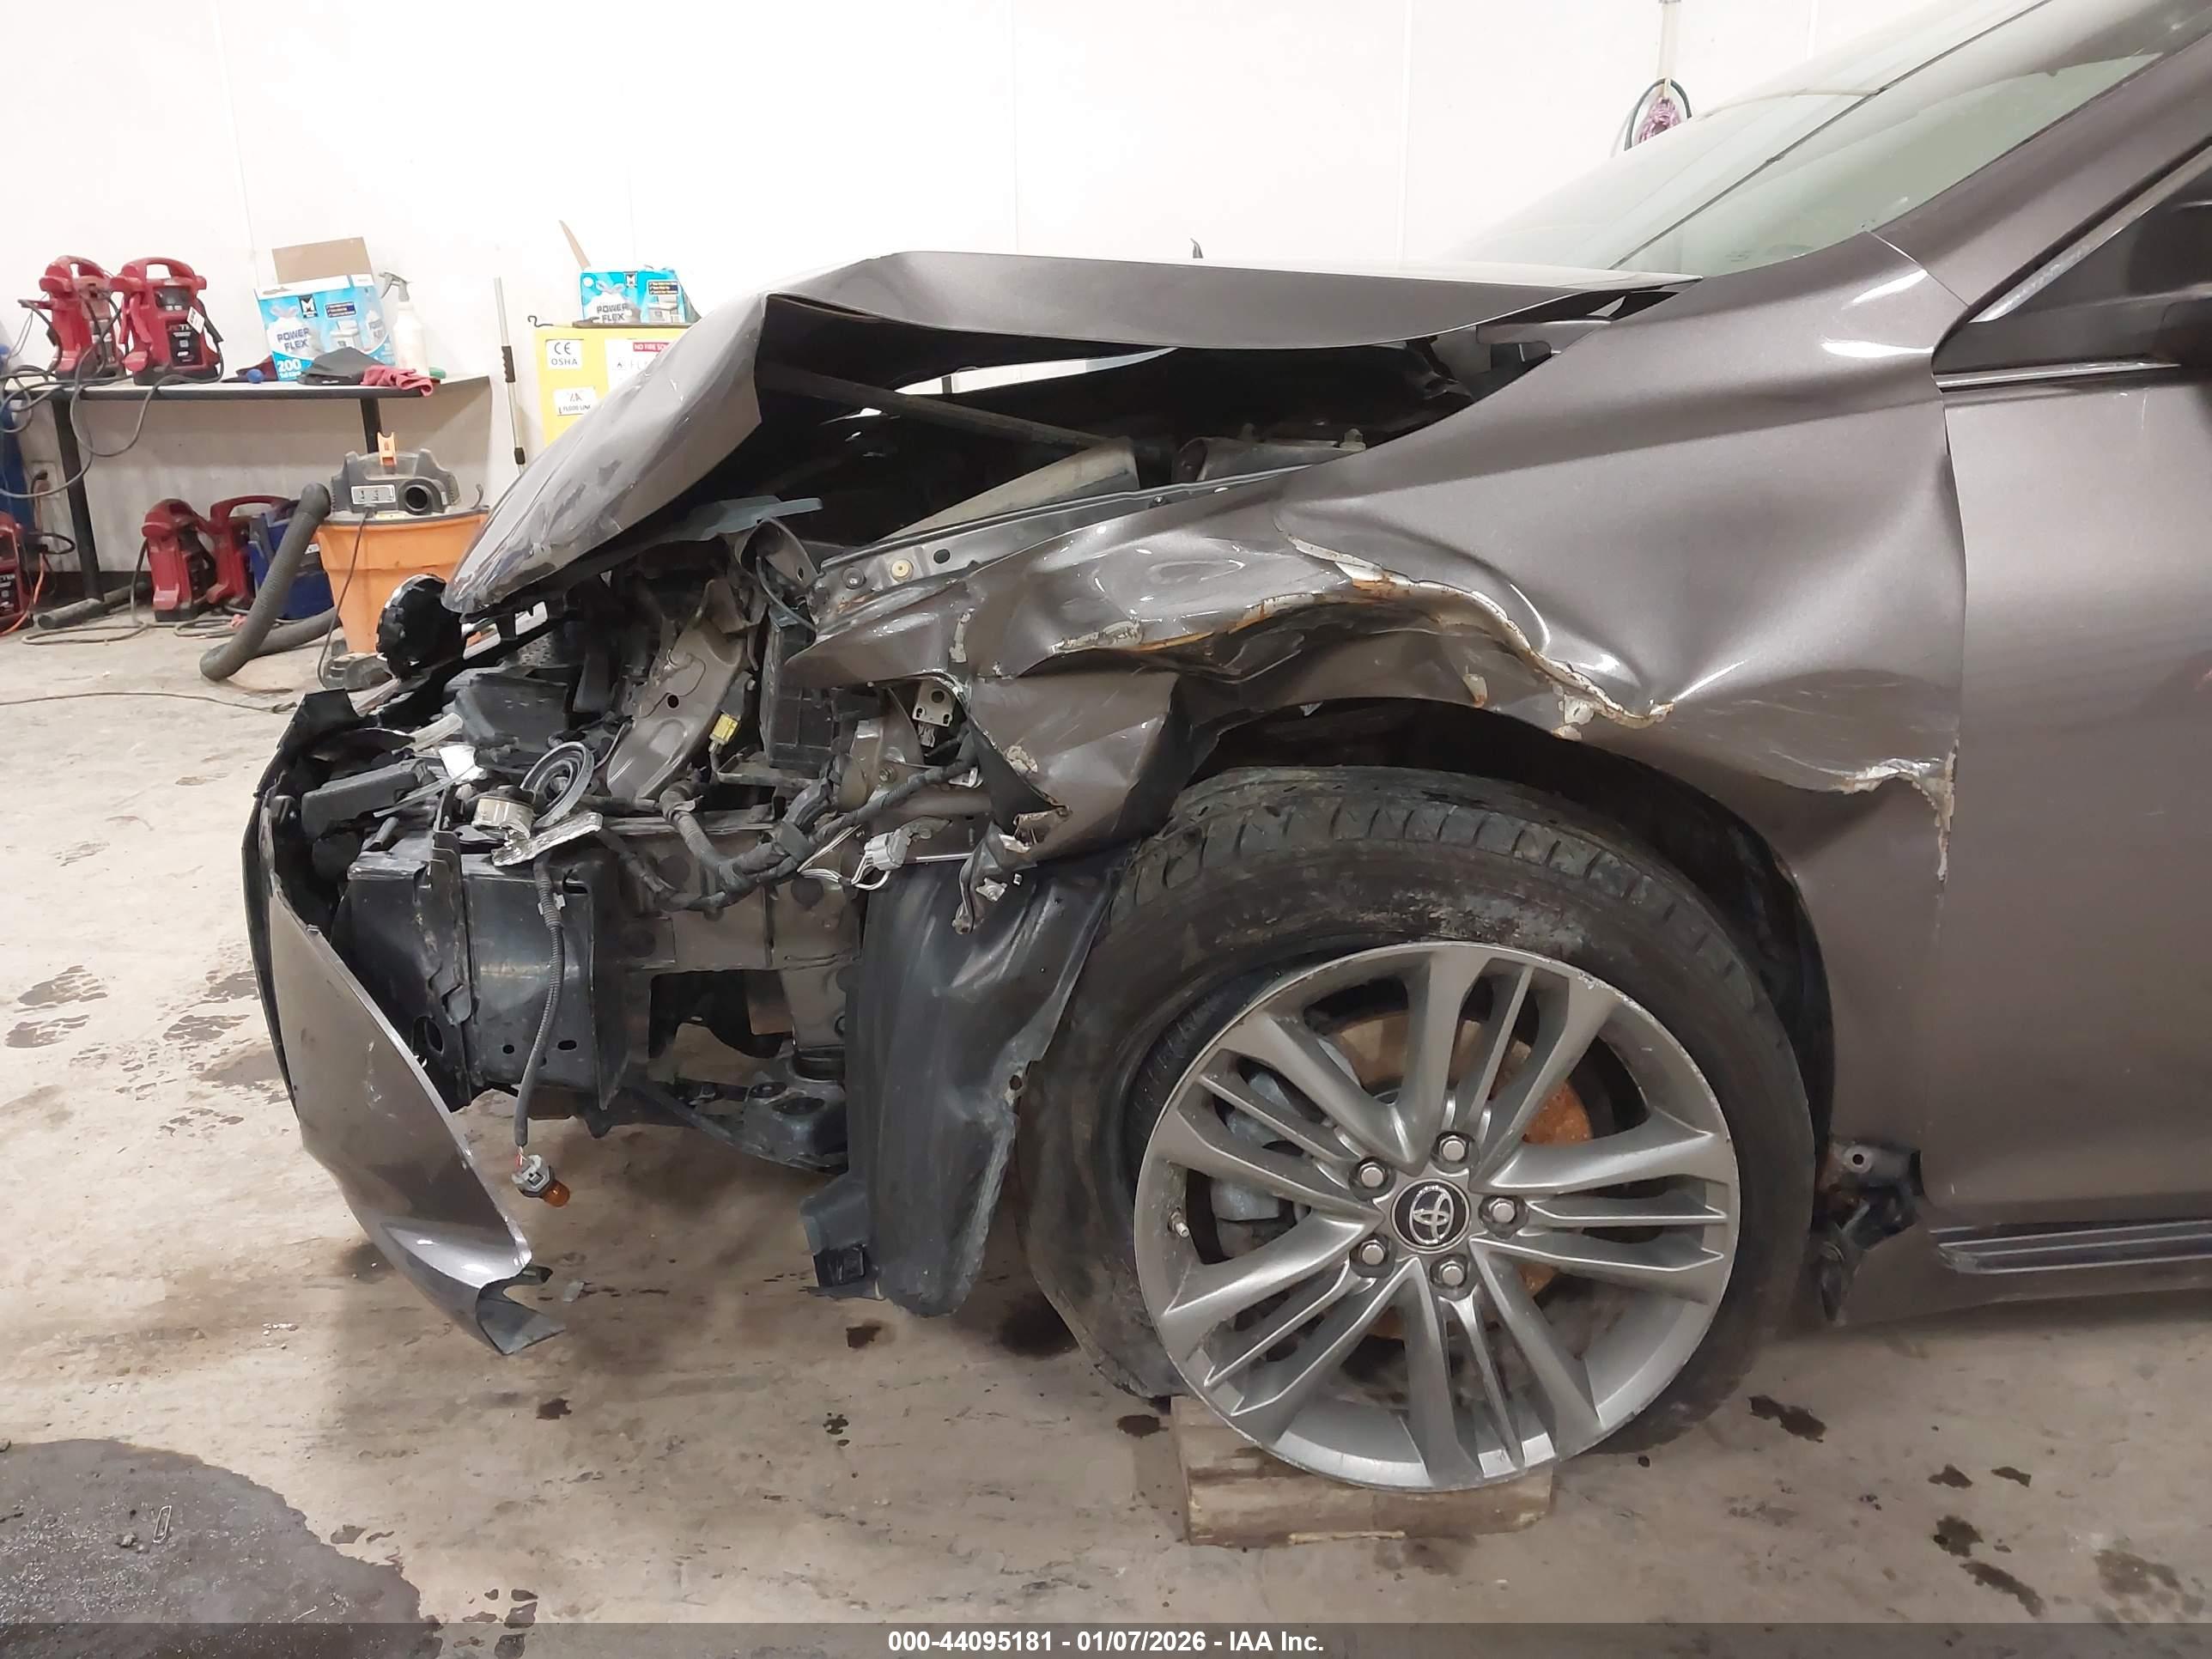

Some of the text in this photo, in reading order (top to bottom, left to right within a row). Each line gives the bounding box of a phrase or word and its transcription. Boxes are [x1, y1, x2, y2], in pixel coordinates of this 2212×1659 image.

[597, 303, 628, 314] POWER
[602, 313, 625, 323] FLEX
[277, 328, 310, 342] POWER
[284, 340, 309, 351] FLEX
[554, 342, 571, 356] CE
[276, 358, 302, 372] 200
